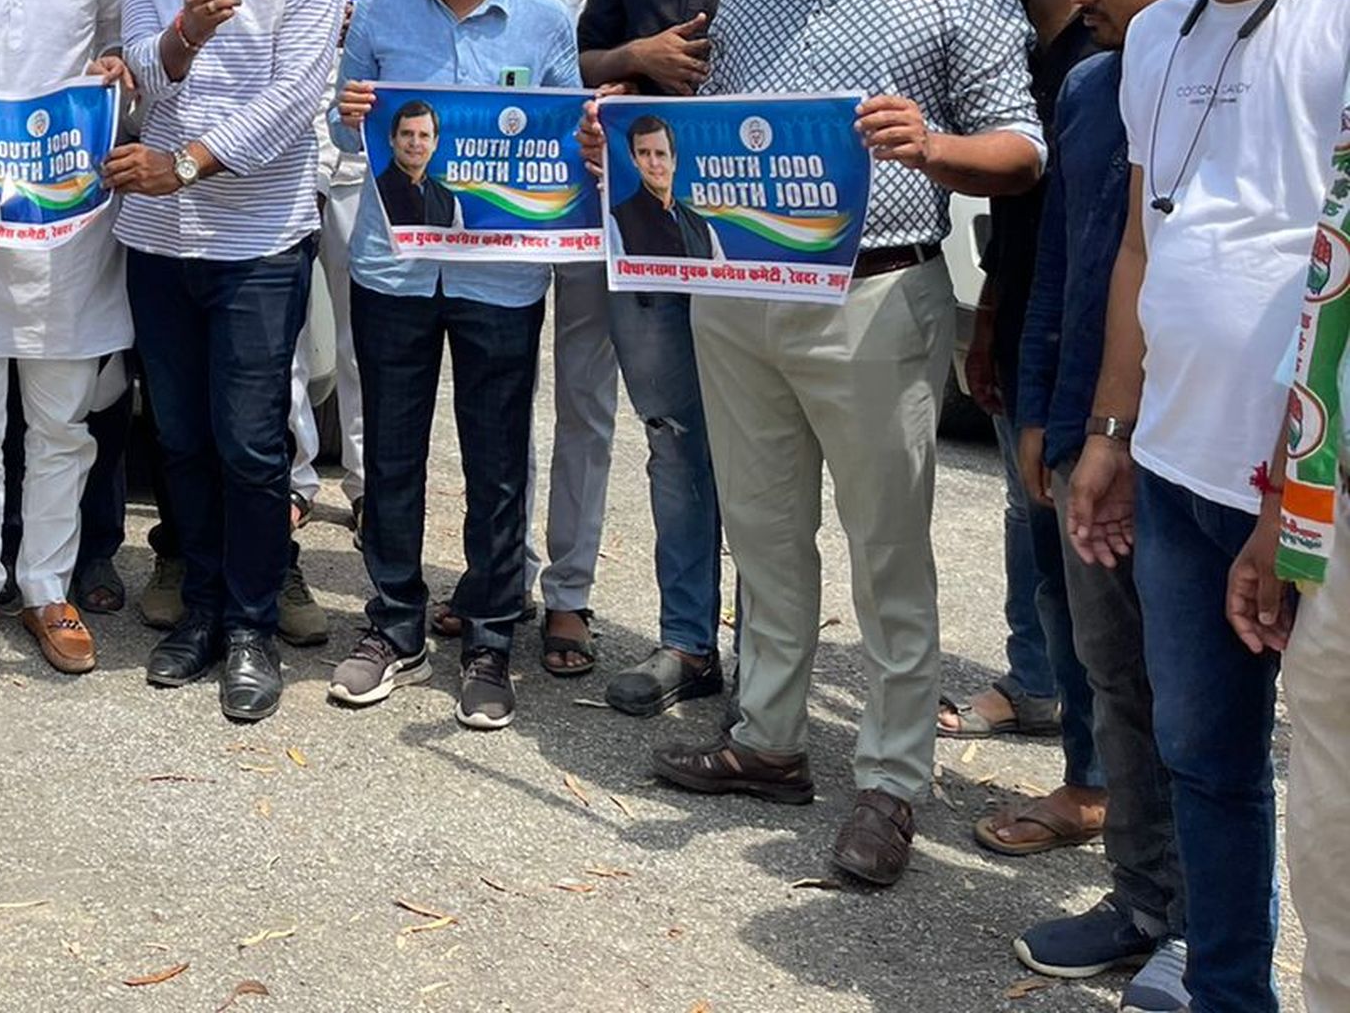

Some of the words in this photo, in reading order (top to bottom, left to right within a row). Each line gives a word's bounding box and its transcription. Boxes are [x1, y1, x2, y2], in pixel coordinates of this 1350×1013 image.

[47, 129, 81, 155] JODO
[455, 138, 510, 157] YOUTH
[515, 139, 560, 157] JODO
[48, 150, 88, 178] JODO
[446, 161, 509, 183] BOOTH
[516, 162, 569, 183] JODO
[695, 155, 761, 178] YOUTH
[769, 155, 824, 178] JODO
[691, 182, 766, 208] BOOTH
[776, 182, 838, 208] JODO
[680, 265, 708, 282] युवक
